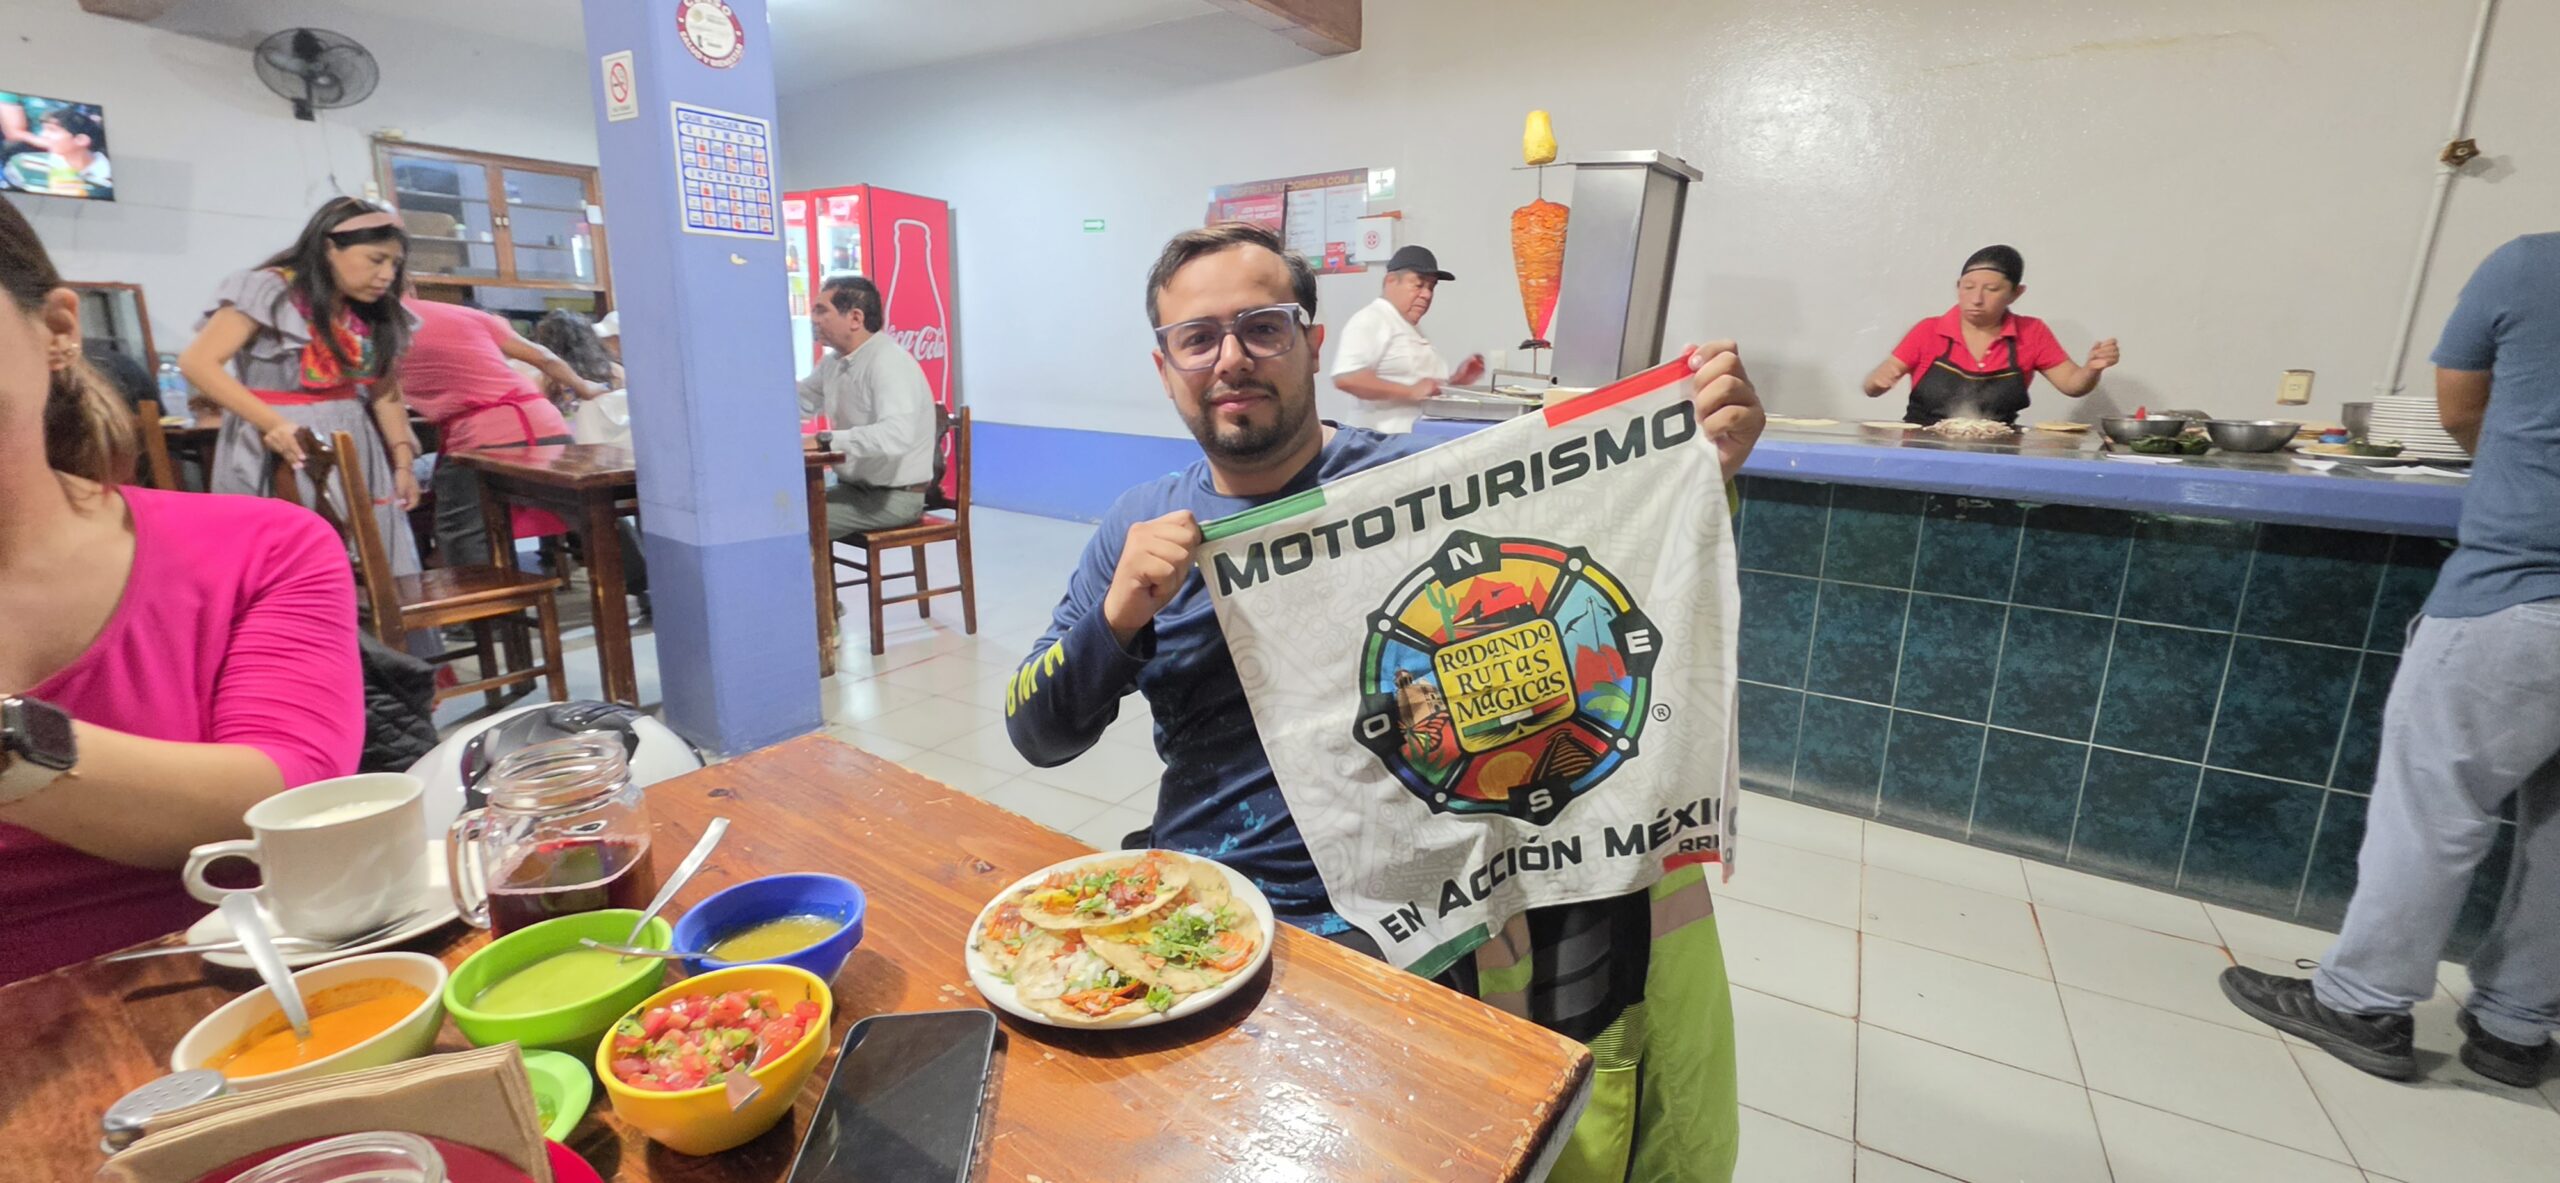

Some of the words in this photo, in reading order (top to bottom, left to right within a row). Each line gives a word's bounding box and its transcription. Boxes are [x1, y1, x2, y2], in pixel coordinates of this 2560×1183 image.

[686, 125, 758, 145] SISMOS
[690, 169, 766, 187] INCENDIOS
[1213, 399, 1698, 597] MOTOTURISMO
[1447, 541, 1484, 572] N
[1624, 628, 1653, 655] E
[1362, 713, 1391, 739] O
[1528, 788, 1554, 813] S
[1379, 901, 1427, 943] EN
[1438, 835, 1584, 919] ACCIÓN
